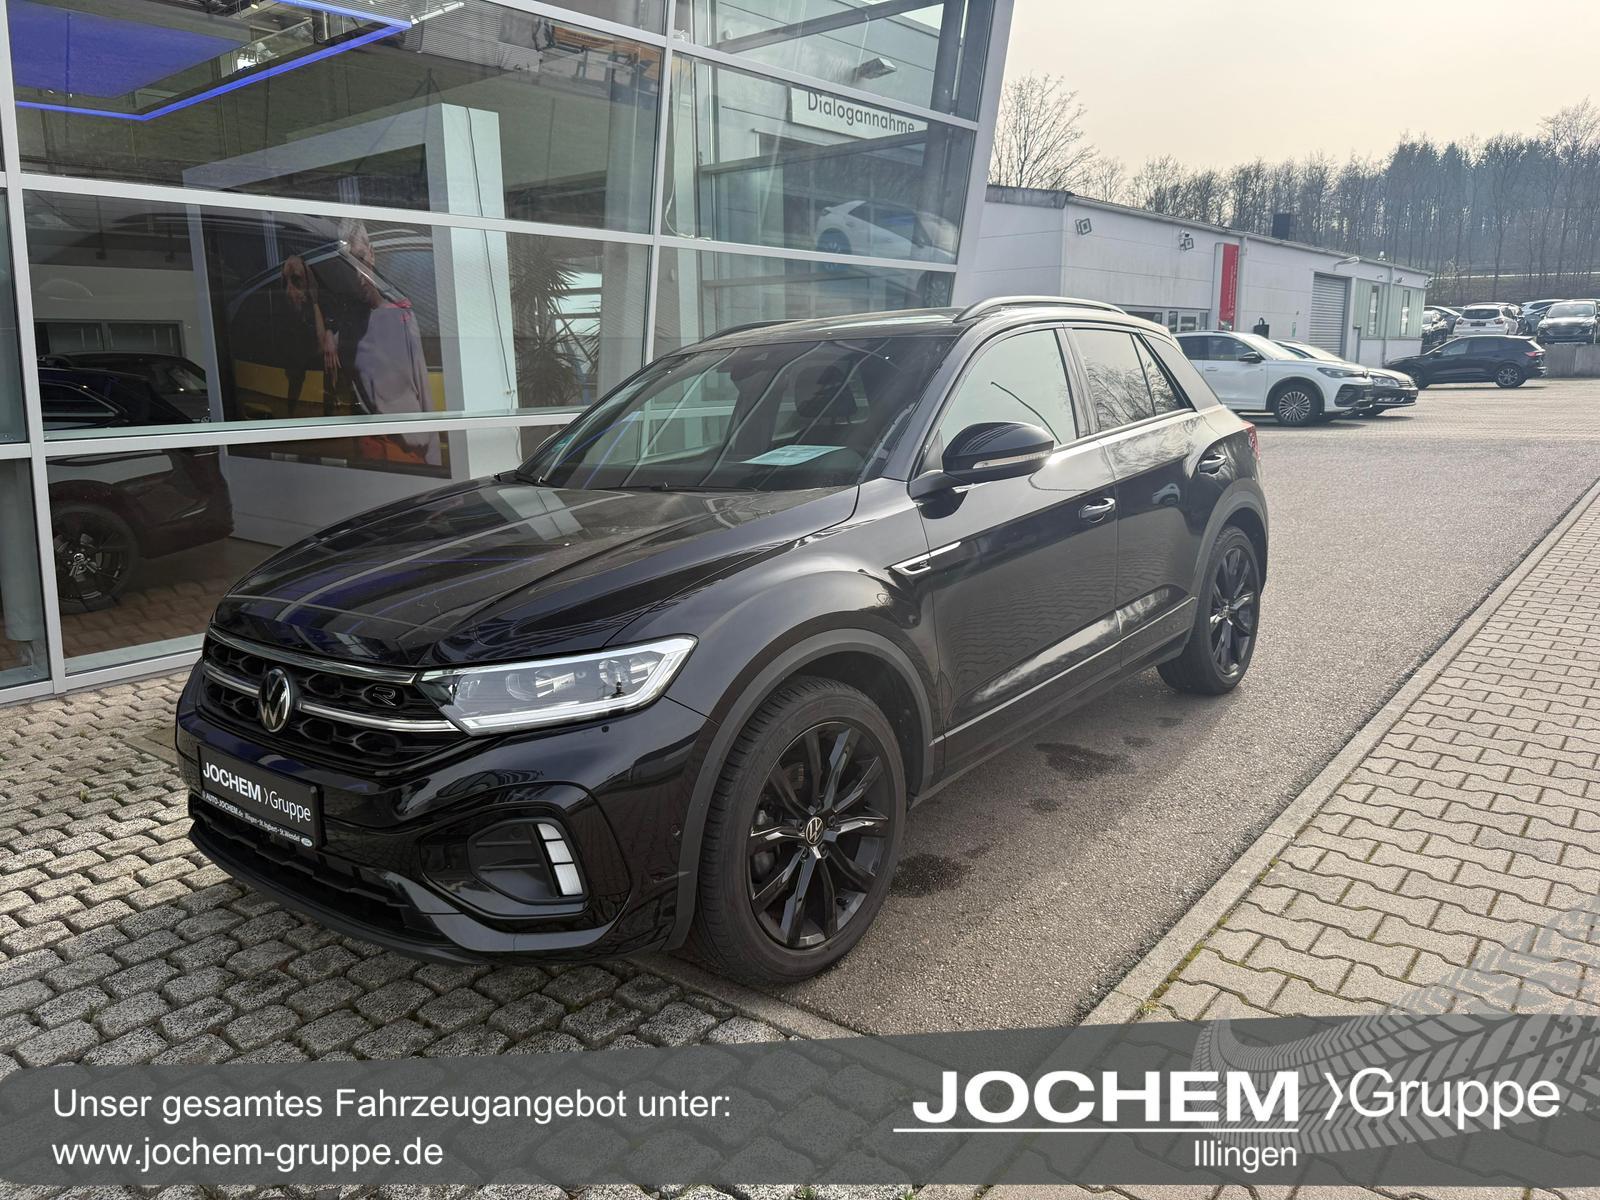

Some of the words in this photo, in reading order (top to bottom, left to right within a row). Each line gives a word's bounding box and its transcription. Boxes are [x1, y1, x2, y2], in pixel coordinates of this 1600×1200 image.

[807, 92, 915, 134] Dialogannahme
[203, 762, 262, 802] JOCHEM
[269, 790, 311, 823] Gruppe
